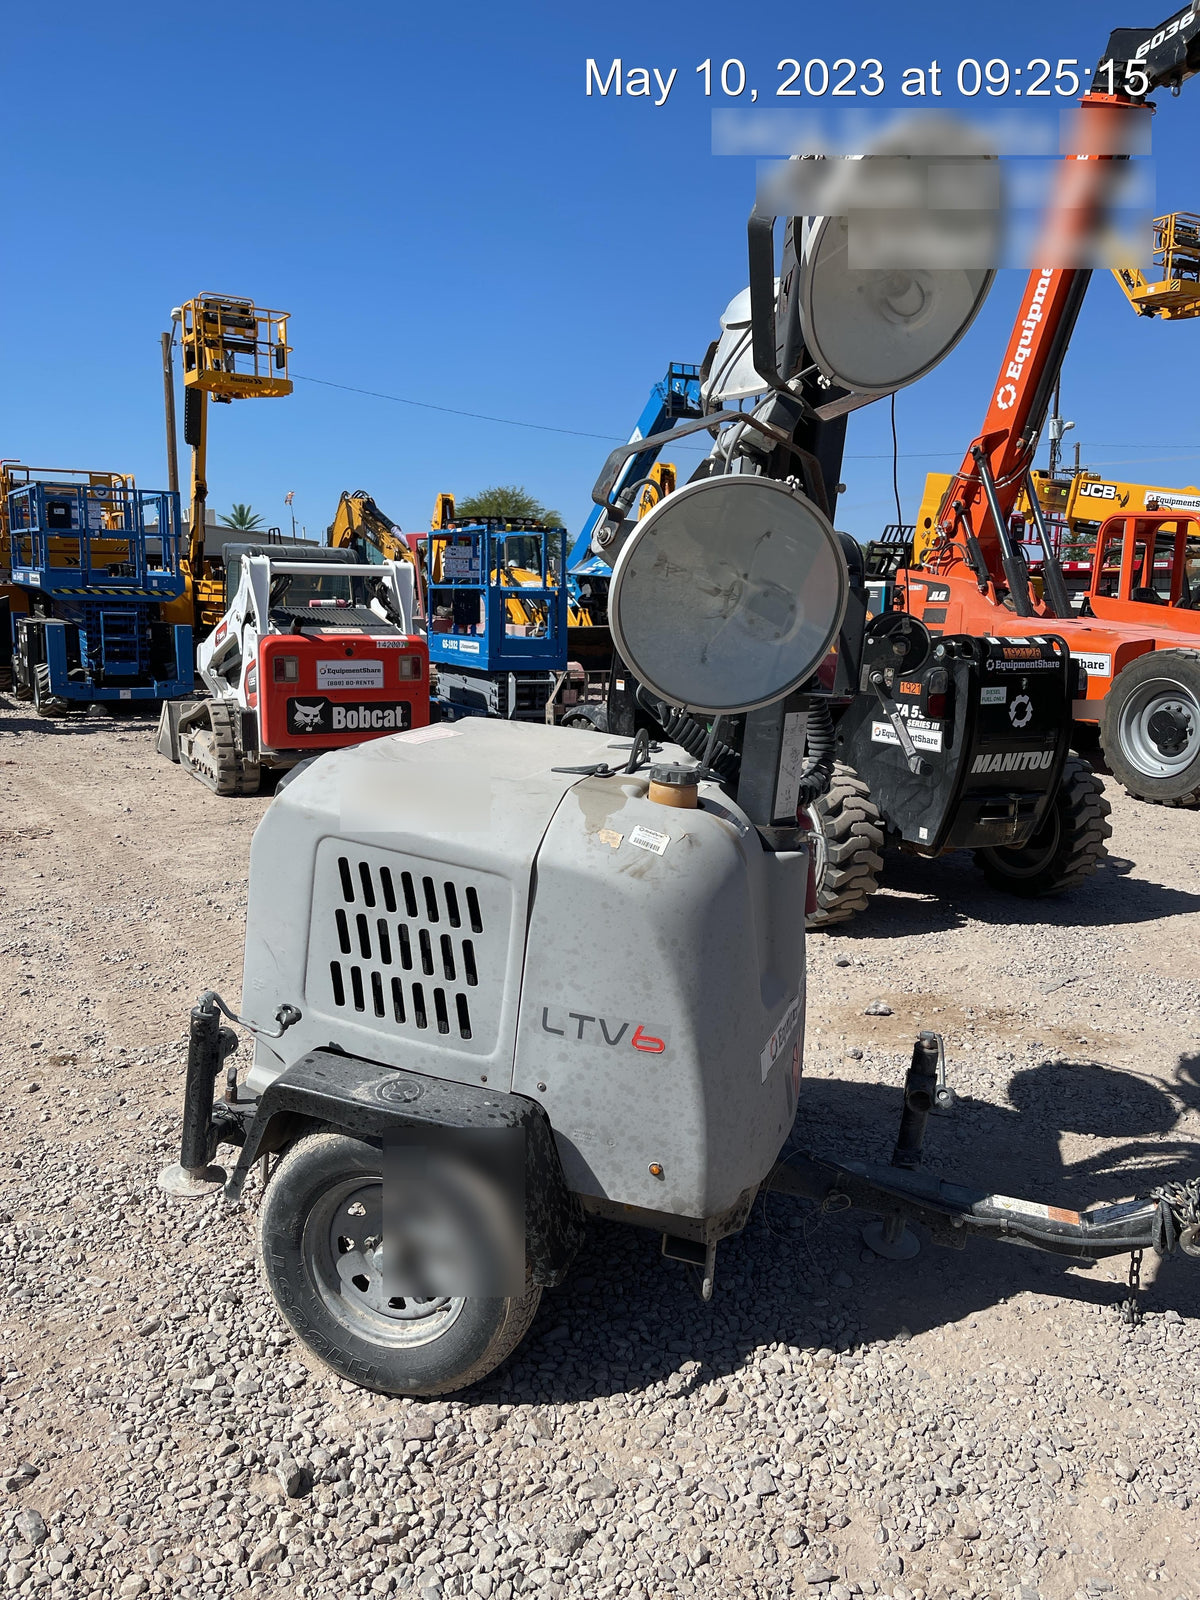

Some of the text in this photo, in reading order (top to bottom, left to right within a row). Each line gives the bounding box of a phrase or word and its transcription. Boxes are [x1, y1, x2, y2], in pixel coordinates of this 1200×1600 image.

[1135, 10, 1196, 60] 6036
[1081, 484, 1116, 499] JCB
[929, 591, 947, 600] JLG
[1005, 648, 1041, 659] 192126
[327, 667, 381, 675] EquipmentShare
[995, 659, 1060, 671] EquipmentShare
[332, 705, 403, 729] Bobcat
[907, 719, 940, 731] SERIES III
[882, 729, 938, 745] EquipntShare
[971, 751, 1054, 773] MANITOU
[541, 1006, 666, 1054] LTV6
